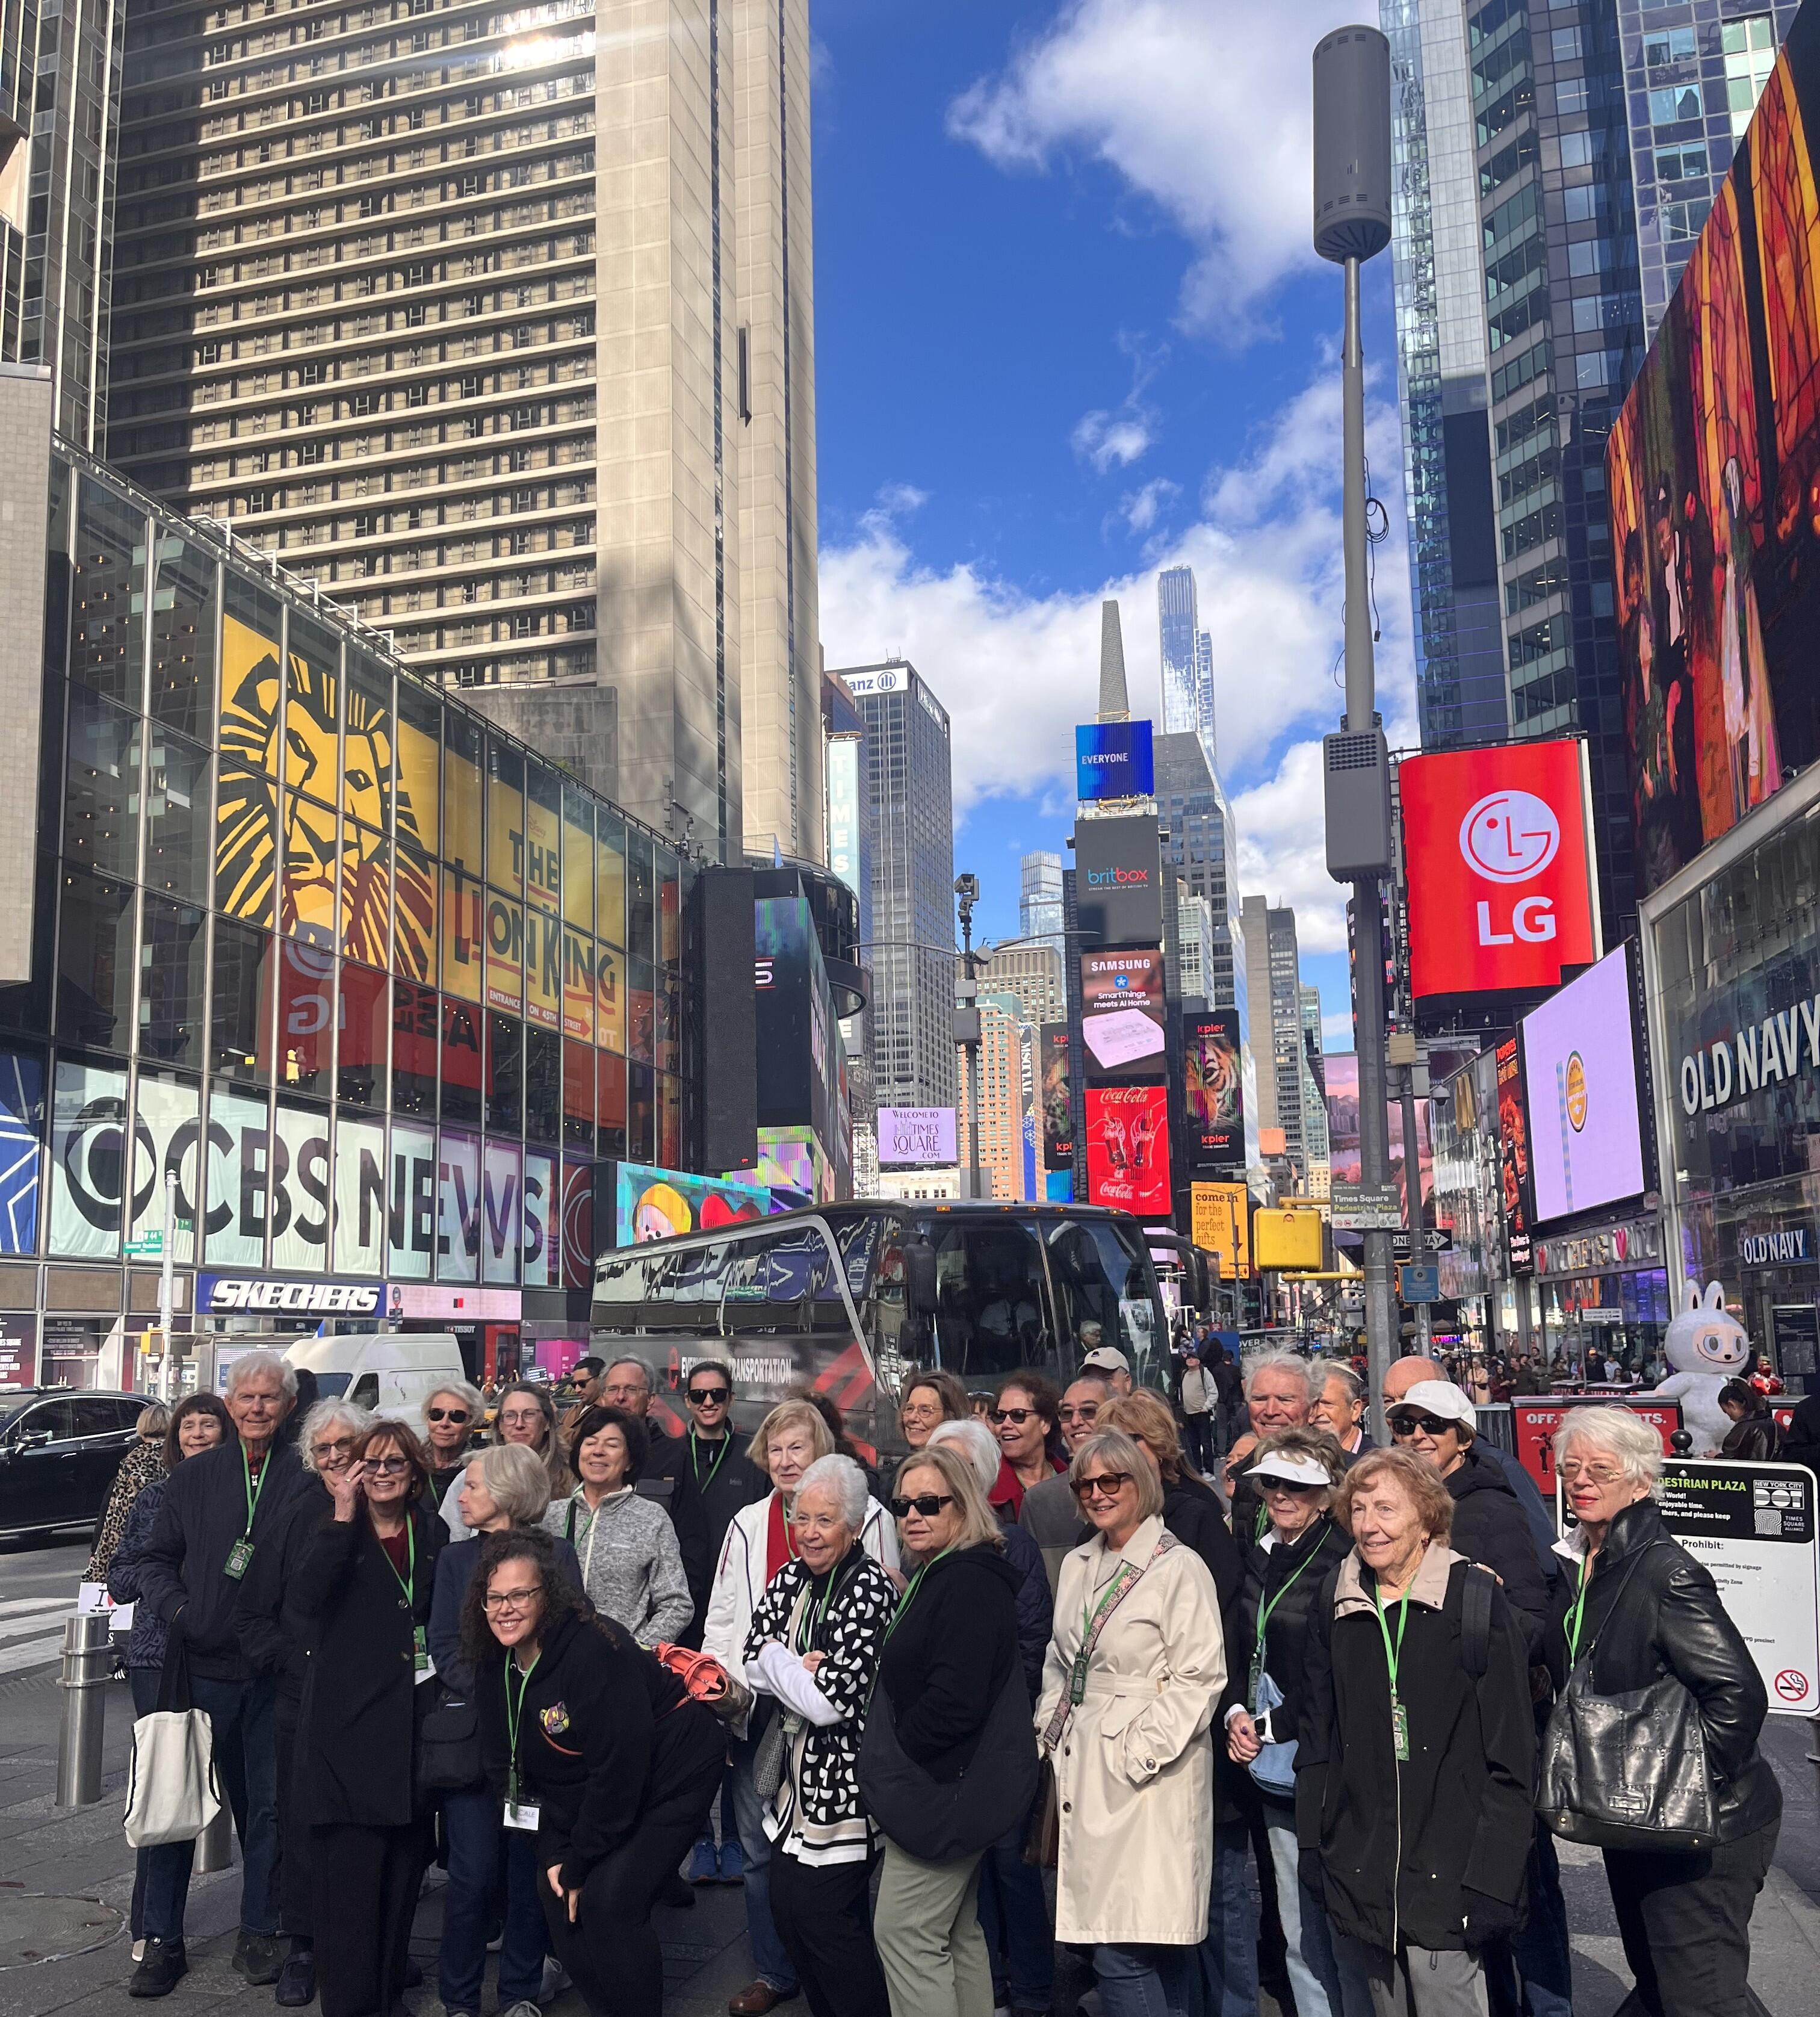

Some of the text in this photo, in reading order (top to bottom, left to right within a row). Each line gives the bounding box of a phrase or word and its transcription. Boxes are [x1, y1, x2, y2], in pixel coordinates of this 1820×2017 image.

[1082, 752, 1128, 764] EVERYONE
[831, 754, 852, 873] TIMES
[509, 829, 559, 893] THE
[1088, 867, 1148, 884] britbox
[1477, 896, 1557, 946] LG
[455, 858, 616, 1003] LION KING
[1091, 959, 1150, 971] SAMSUNG
[1098, 991, 1147, 1000] SmartThings
[489, 991, 581, 1032] ENTRANCE ON 45TH STREET
[1681, 993, 1820, 1115] OLD NAVY
[1100, 1086, 1149, 1104] Coca-Cola
[912, 1124, 939, 1135] TIMES
[893, 1135, 939, 1155] SQUARE
[1201, 1134, 1230, 1144] kpler
[1056, 1142, 1072, 1151] kpl
[164, 1115, 545, 1265] CBS NEWS
[1334, 1194, 1389, 1203] Times Square
[1196, 1203, 1222, 1216] for the
[1196, 1221, 1224, 1234] perfect
[149, 1232, 157, 1240] 44
[1196, 1233, 1215, 1246] gifts
[1392, 1237, 1410, 1245] ONE
[1744, 1229, 1804, 1264] OLD NAVY
[210, 1280, 380, 1310] SKECHERS
[728, 1358, 792, 1384] TRANSPORTATION
[1526, 1413, 1558, 1424] OFF.
[1657, 1477, 1747, 1492] DESTRIAN PLAZA
[1682, 1539, 1724, 1550] Prohibit:
